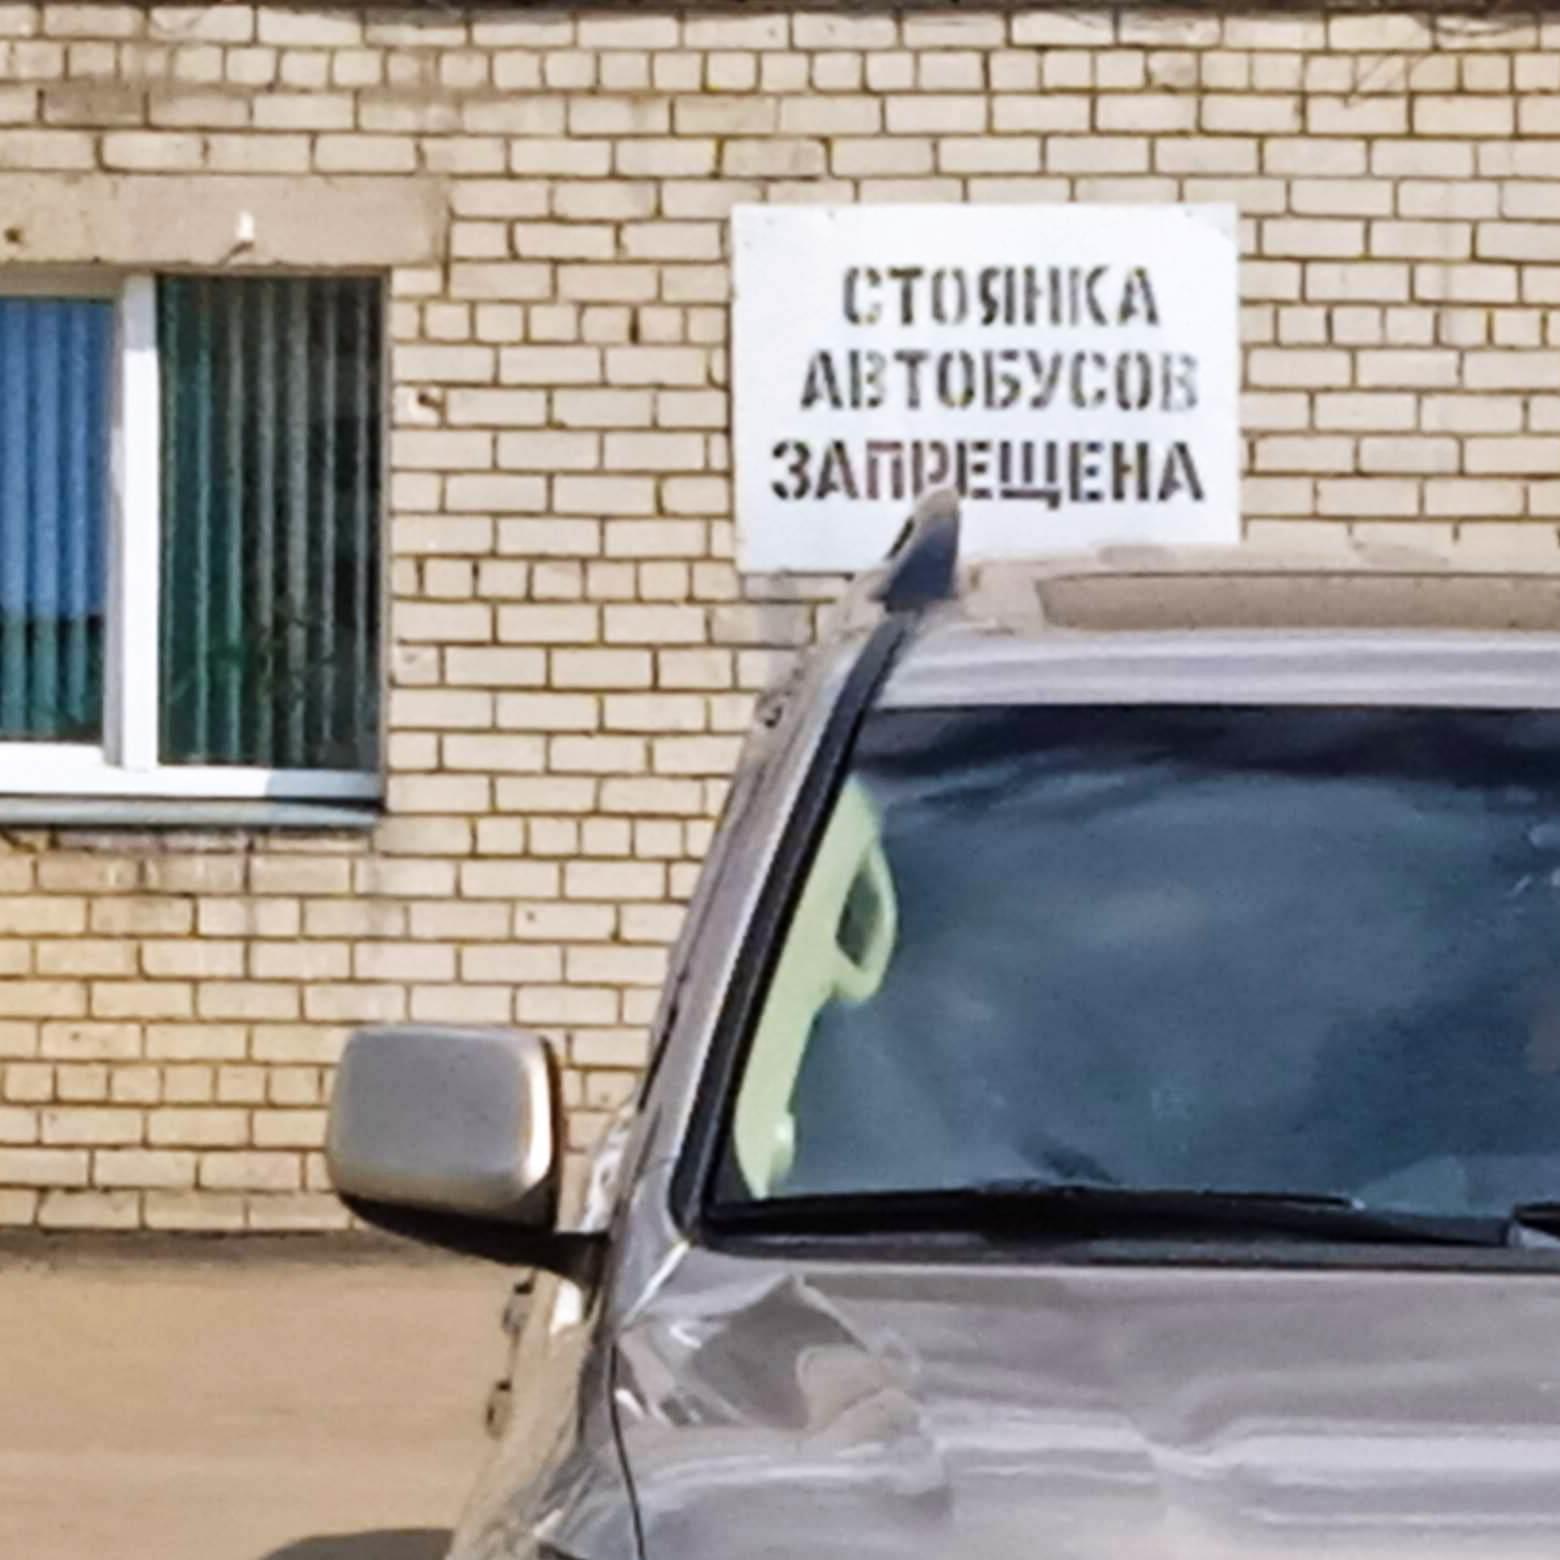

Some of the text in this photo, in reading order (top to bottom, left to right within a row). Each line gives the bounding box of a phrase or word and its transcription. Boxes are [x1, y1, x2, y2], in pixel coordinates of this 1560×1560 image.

[841, 264, 1161, 328] СТОЯНКА
[799, 347, 1199, 413] АВТОБУСОВ
[770, 437, 1207, 509] ЗАПРЕЩЕНА
